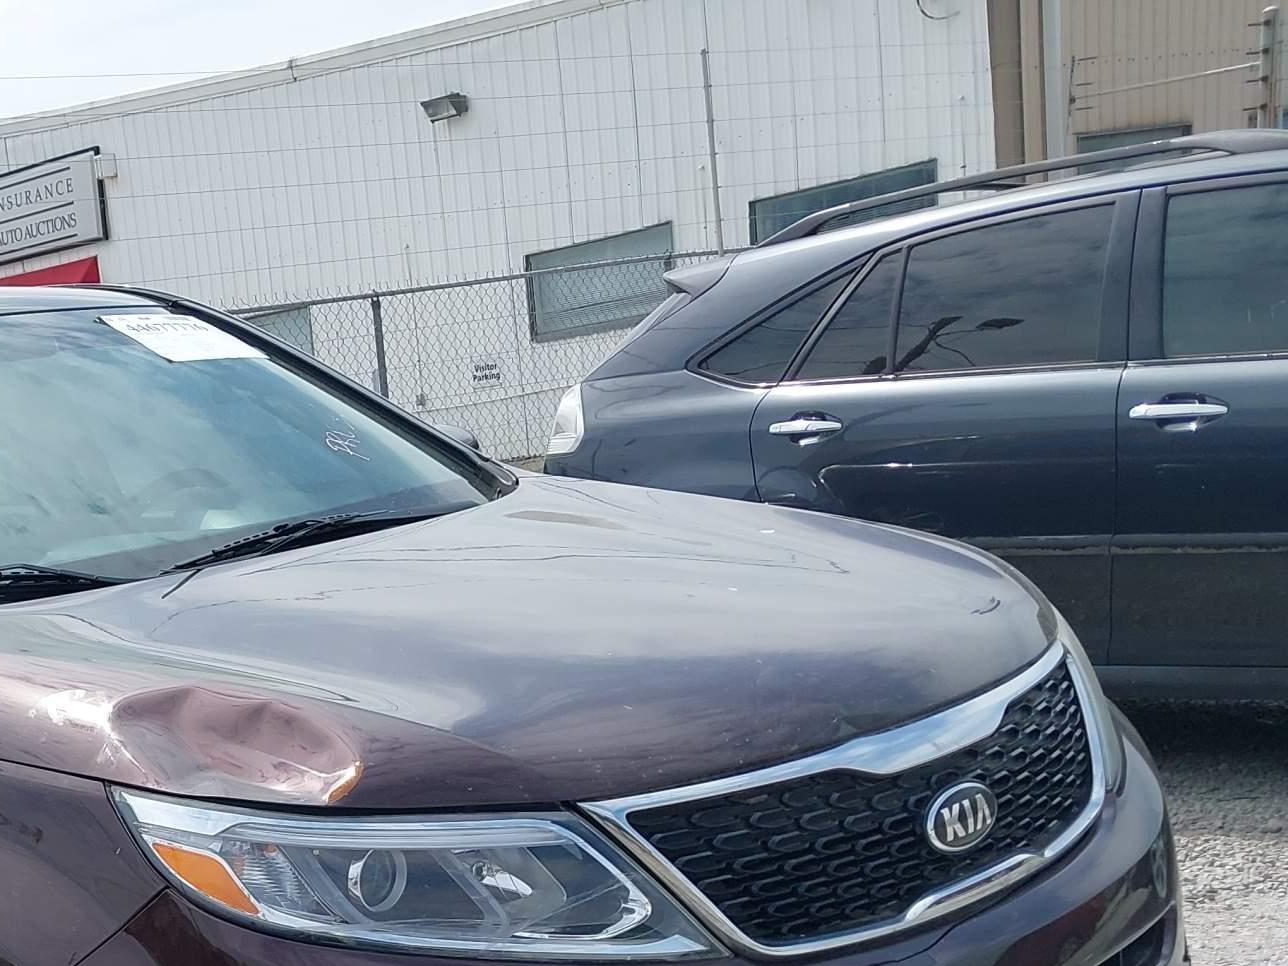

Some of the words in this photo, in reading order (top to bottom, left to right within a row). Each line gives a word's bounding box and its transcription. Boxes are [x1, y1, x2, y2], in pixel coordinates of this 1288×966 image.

[23, 212, 77, 240] AUCTIONS
[472, 372, 501, 382] Parking
[473, 363, 497, 373] Visitor
[940, 793, 992, 842] KIA
